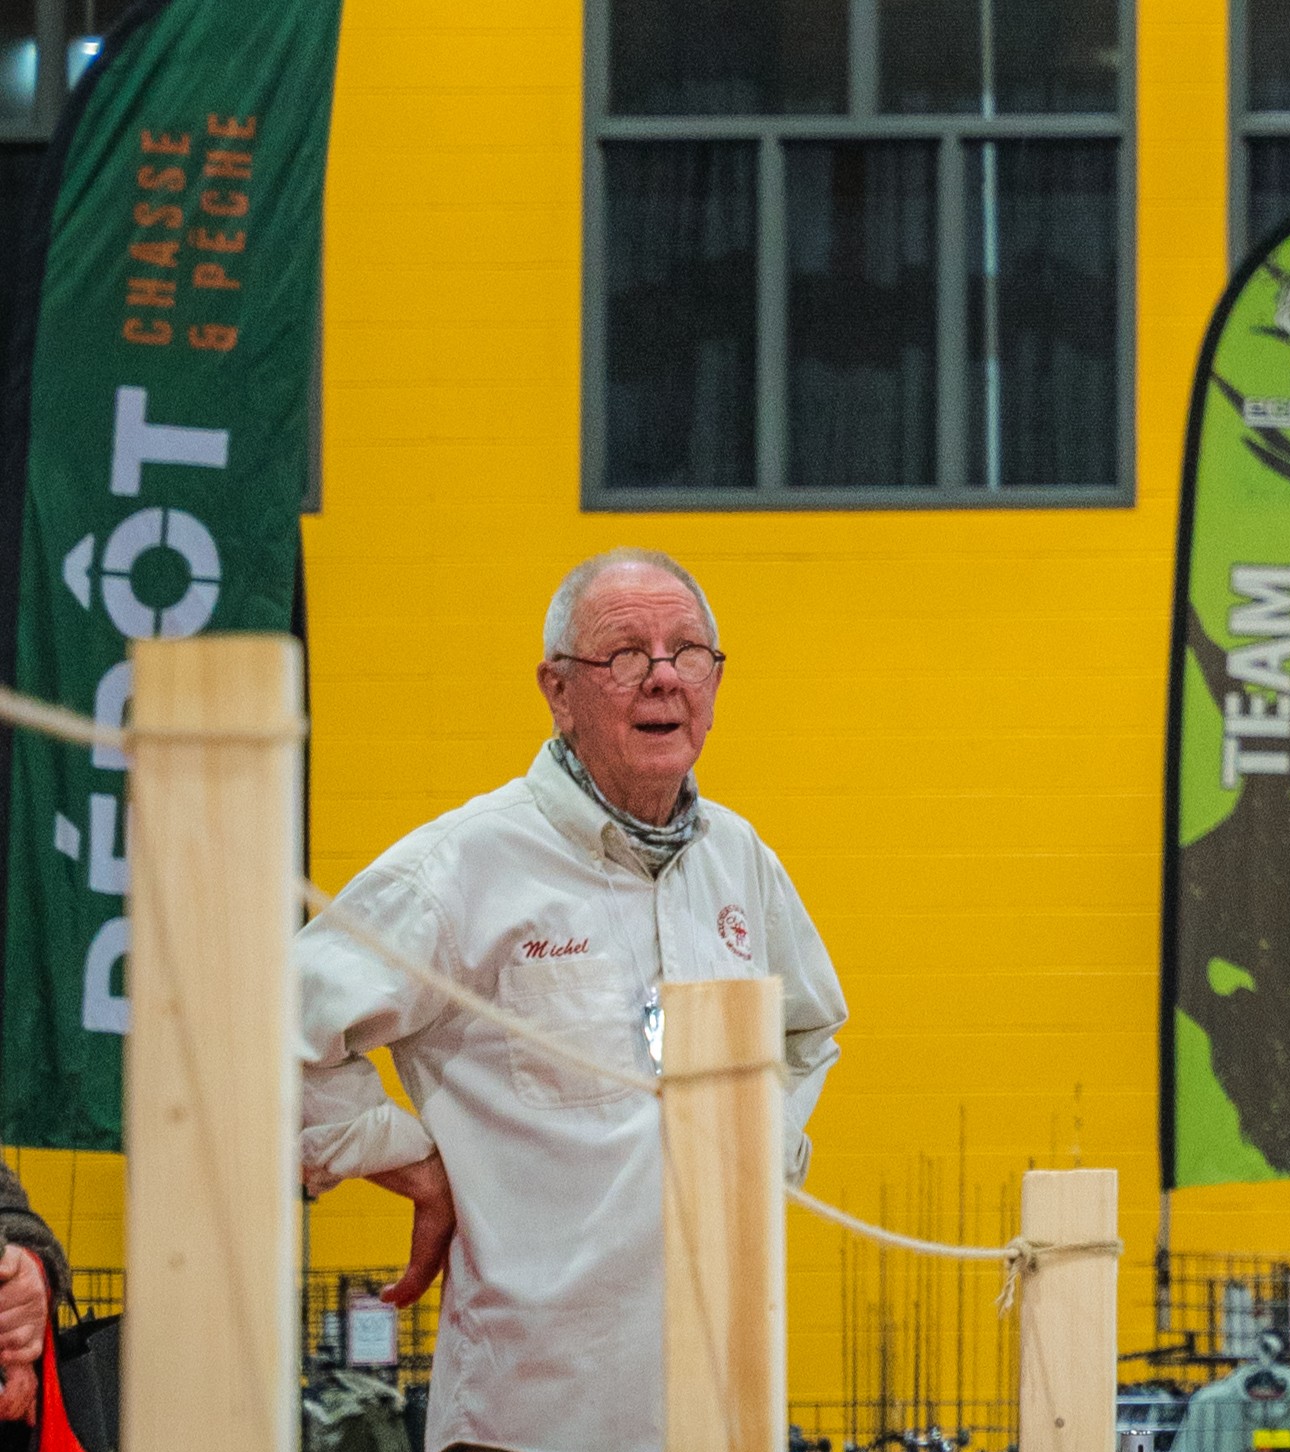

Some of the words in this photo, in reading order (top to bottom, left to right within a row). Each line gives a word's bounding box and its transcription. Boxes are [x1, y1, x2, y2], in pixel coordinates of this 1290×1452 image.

[123, 129, 190, 345] CHASSE
[188, 113, 257, 290] PÊCHE
[188, 324, 238, 351] &
[522, 937, 589, 959] Michel
